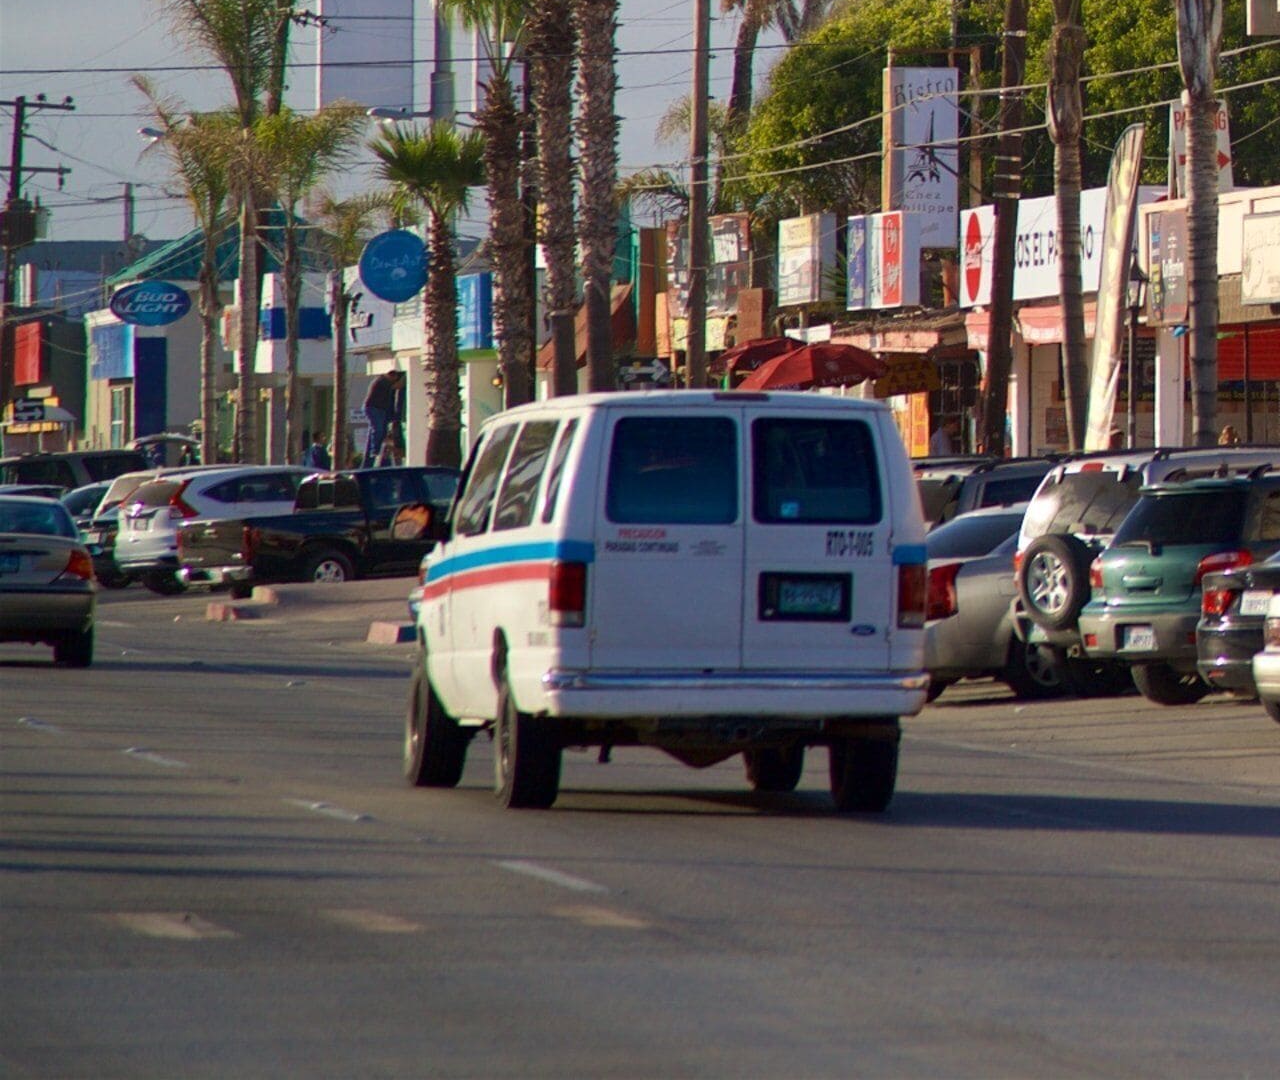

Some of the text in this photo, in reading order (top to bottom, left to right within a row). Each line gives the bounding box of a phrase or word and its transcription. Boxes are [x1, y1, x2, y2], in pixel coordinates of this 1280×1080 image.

[897, 203, 954, 214] hilippe
[134, 292, 178, 303] BUD
[123, 303, 183, 313] LIGHT
